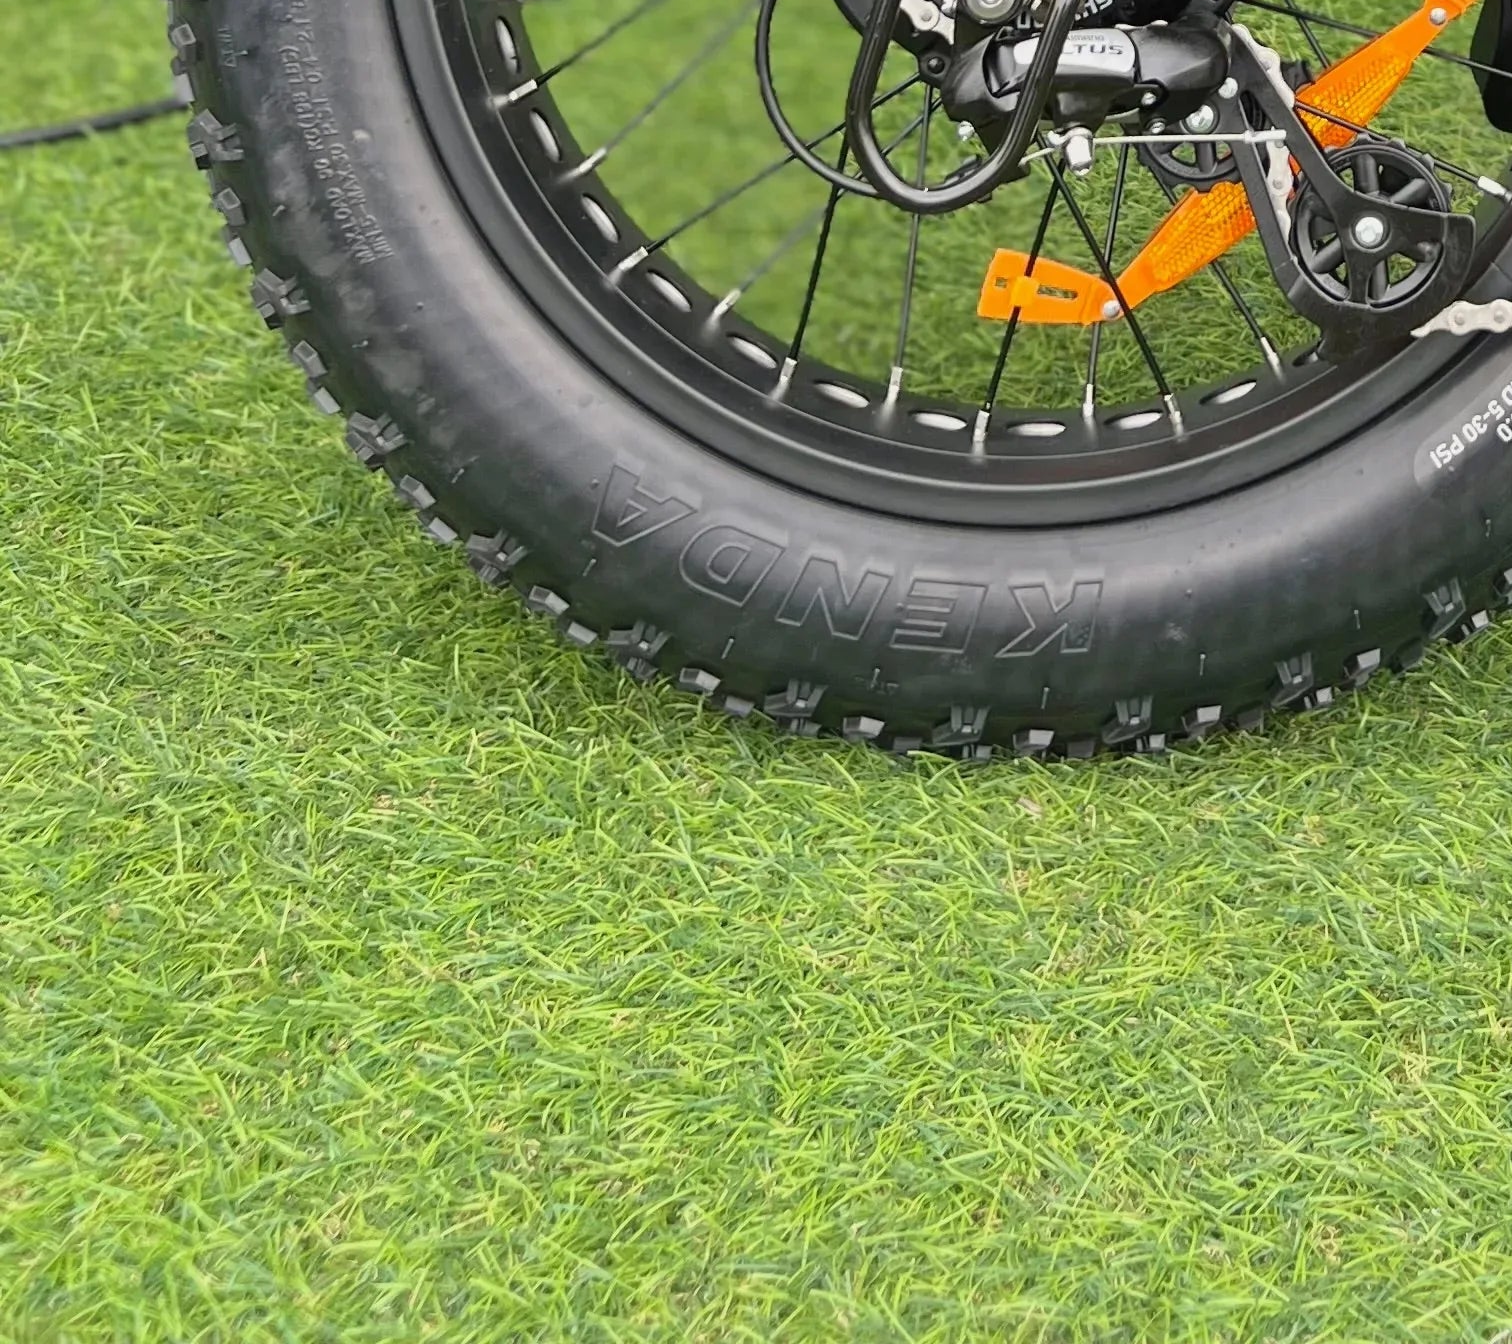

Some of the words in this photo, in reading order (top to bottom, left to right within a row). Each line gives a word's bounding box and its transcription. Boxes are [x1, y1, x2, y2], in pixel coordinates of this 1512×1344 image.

[1062, 43, 1125, 55] TUS
[1461, 399, 1505, 443] 5-30
[1429, 433, 1465, 470] PSI
[591, 464, 1104, 659] KENDA
